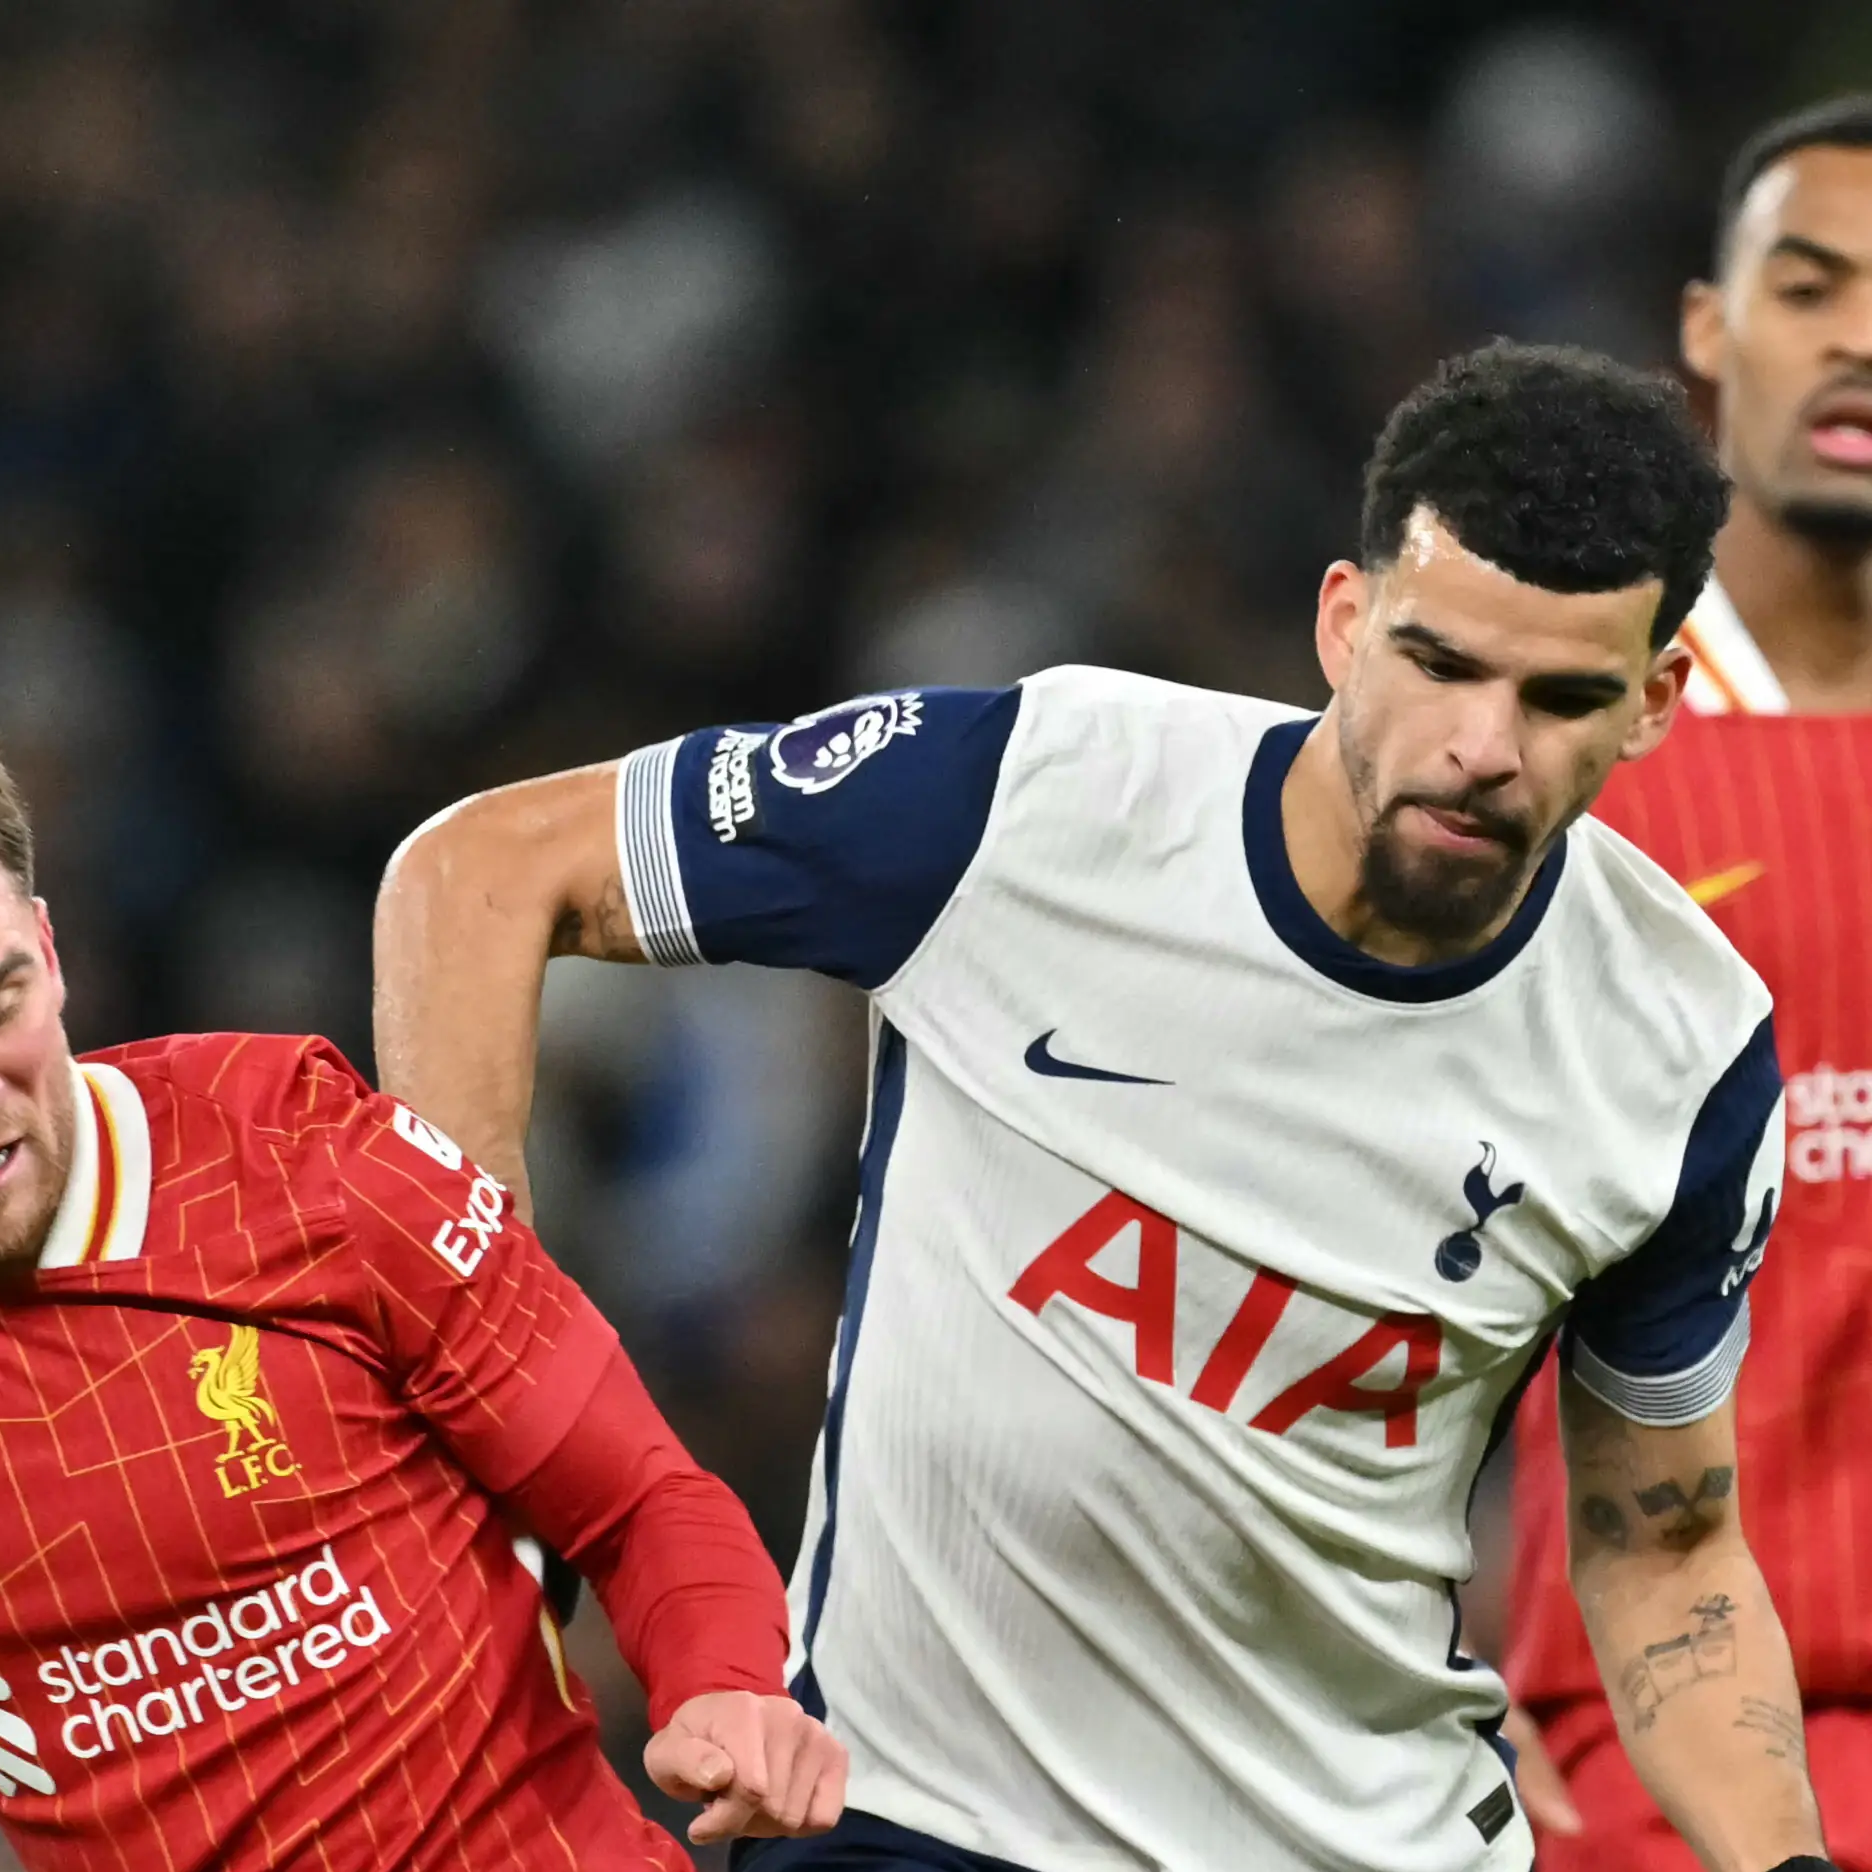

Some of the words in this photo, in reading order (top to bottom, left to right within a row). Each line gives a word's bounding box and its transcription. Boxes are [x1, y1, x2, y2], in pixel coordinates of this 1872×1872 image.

[1008, 1186, 1439, 1449] AIA
[38, 1543, 351, 1704] standard
[61, 1585, 392, 1759] chartered
